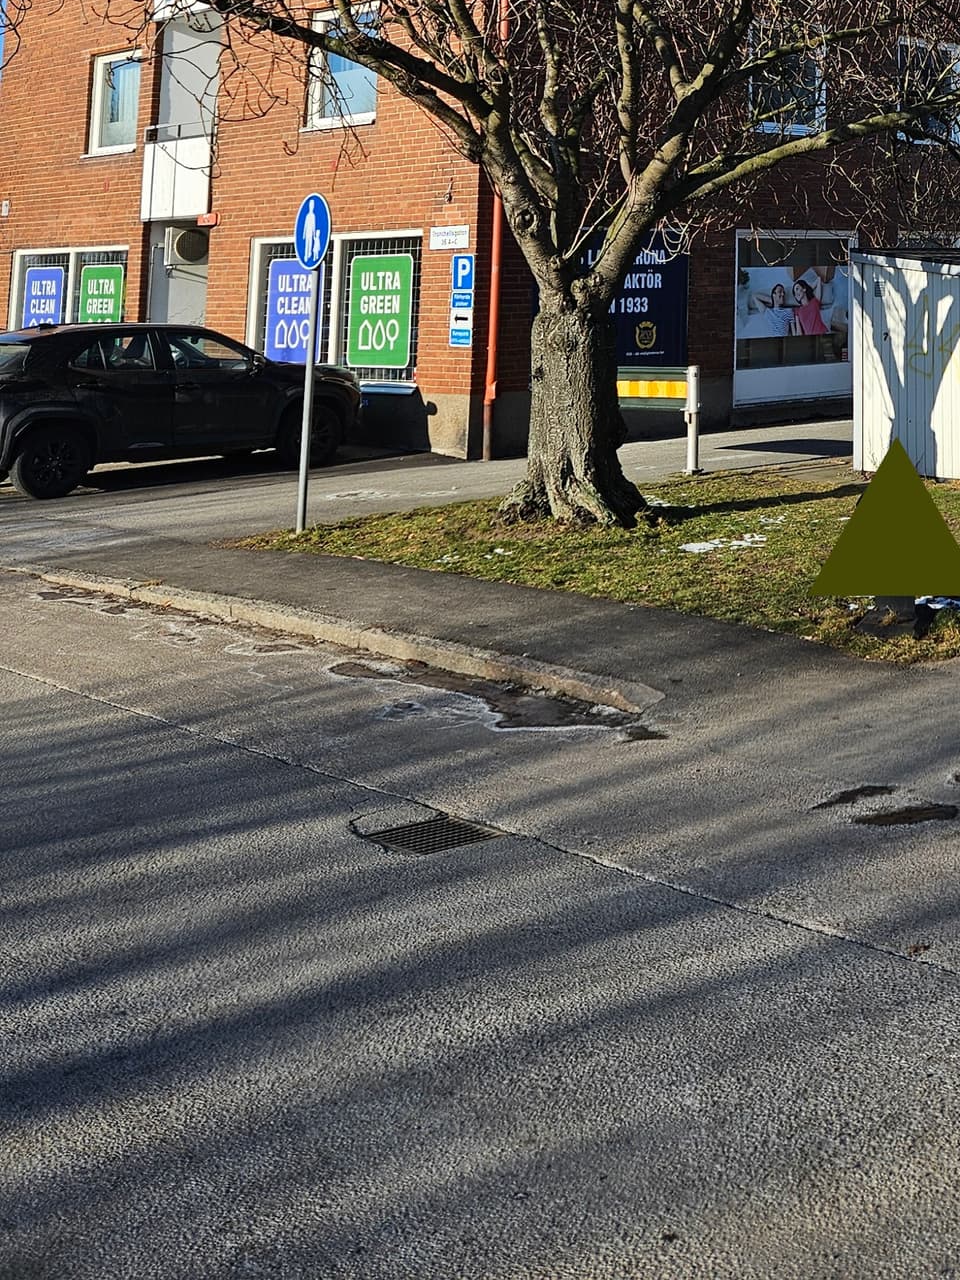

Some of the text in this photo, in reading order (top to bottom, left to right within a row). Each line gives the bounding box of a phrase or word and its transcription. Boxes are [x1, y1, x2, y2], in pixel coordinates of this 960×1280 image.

[361, 271, 401, 291] ULTRA
[457, 258, 471, 287] P
[624, 269, 662, 289] AKTÖR
[31, 280, 56, 296] ULTRA
[87, 279, 115, 295] ULTRA
[278, 273, 313, 293] ULTRA
[30, 298, 56, 314] CLEAN
[86, 298, 114, 314] GREEN
[360, 294, 401, 314] GREEN
[619, 296, 649, 313] 1933
